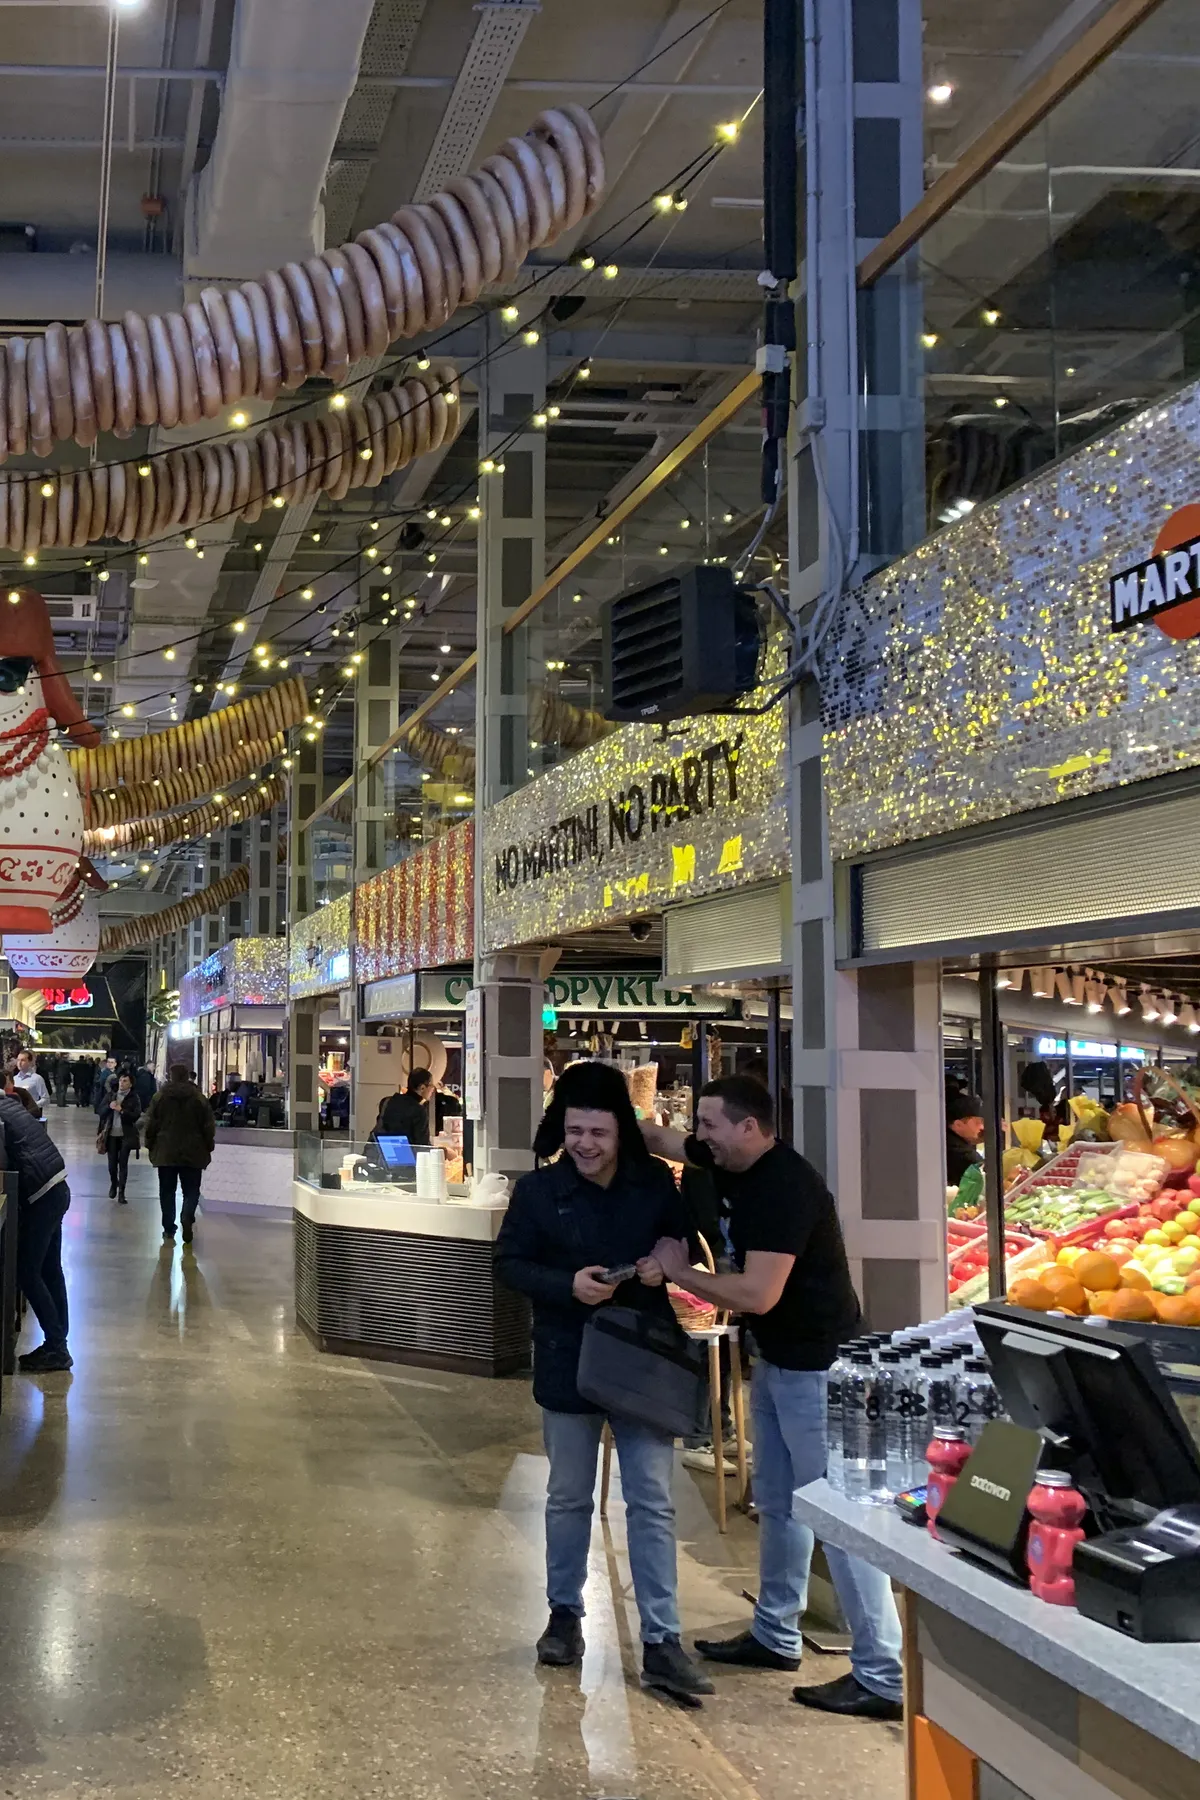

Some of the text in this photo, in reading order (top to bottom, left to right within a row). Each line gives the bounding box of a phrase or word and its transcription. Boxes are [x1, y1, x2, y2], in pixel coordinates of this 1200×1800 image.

[494, 732, 744, 894] NO MARTINI, NO PARTY
